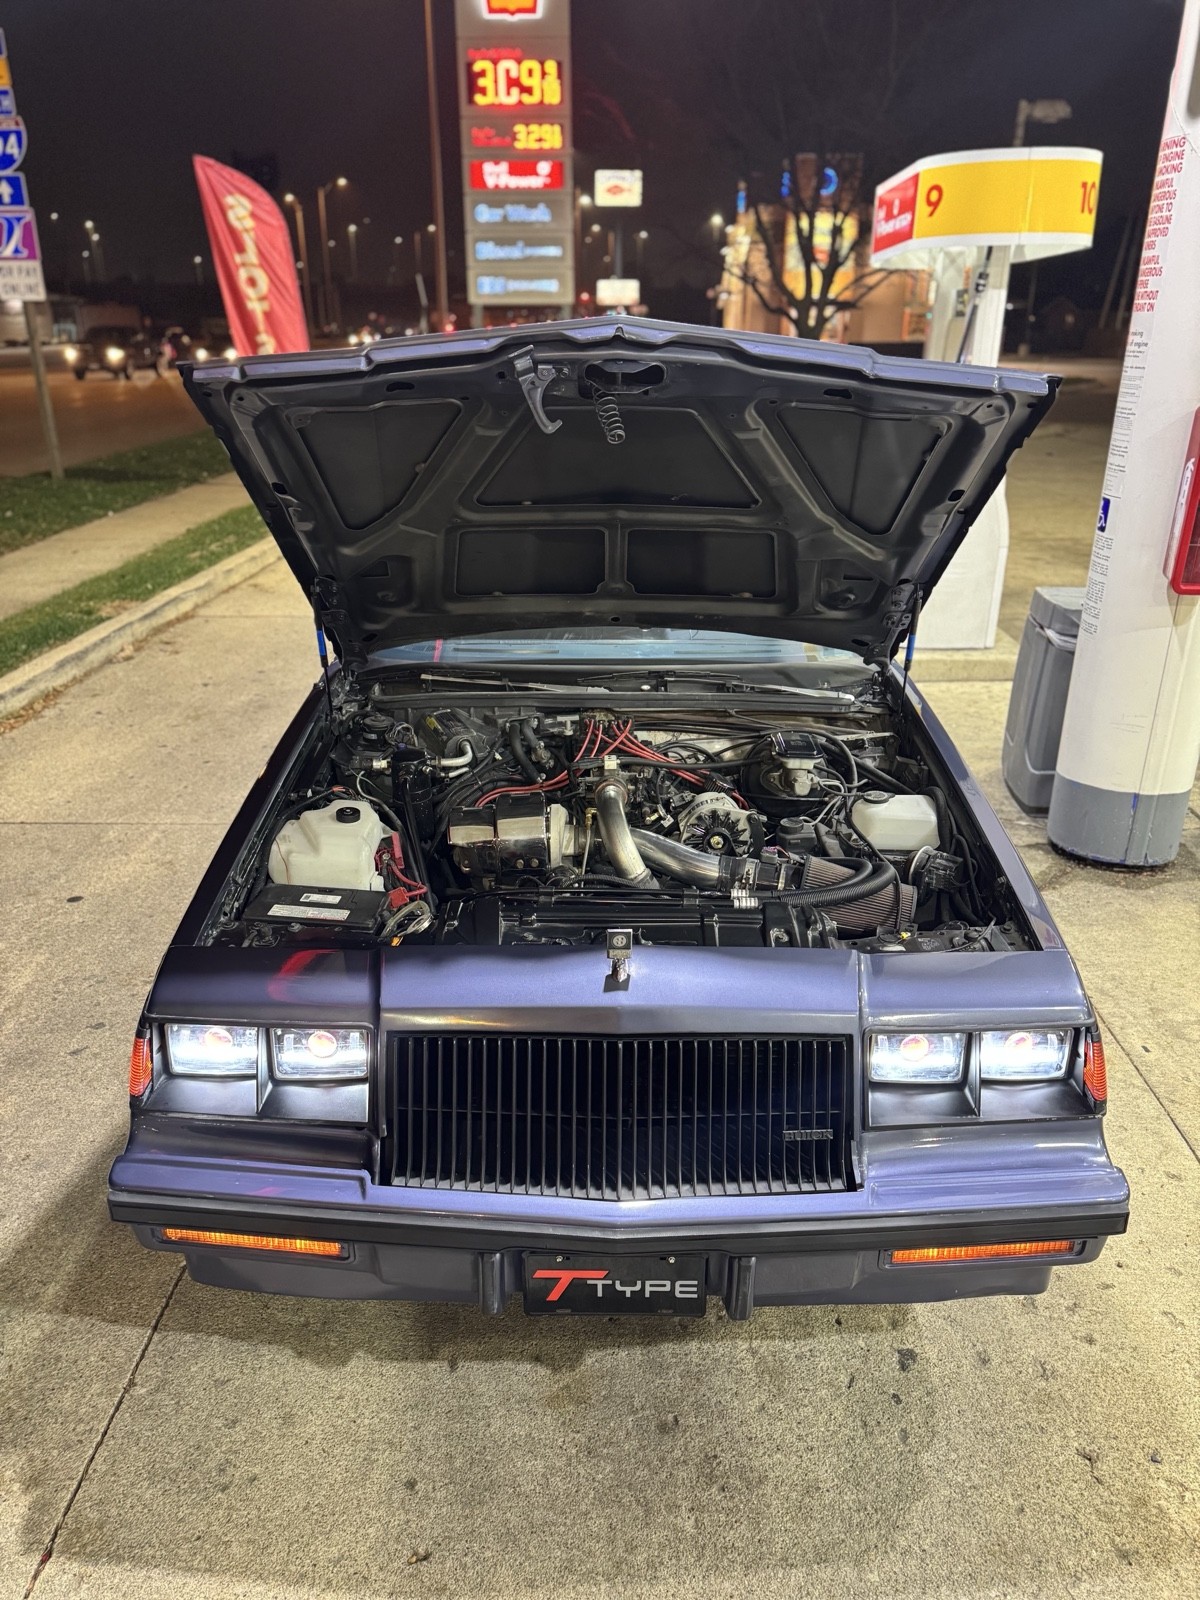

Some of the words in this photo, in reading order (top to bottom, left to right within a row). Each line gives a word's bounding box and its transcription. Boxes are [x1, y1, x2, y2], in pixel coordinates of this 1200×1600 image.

[0, 132, 20, 161] 4
[926, 184, 944, 217] 9
[1147, 302, 1155, 312] ON
[532, 1269, 610, 1302] T
[586, 1280, 699, 1299] TYPE
